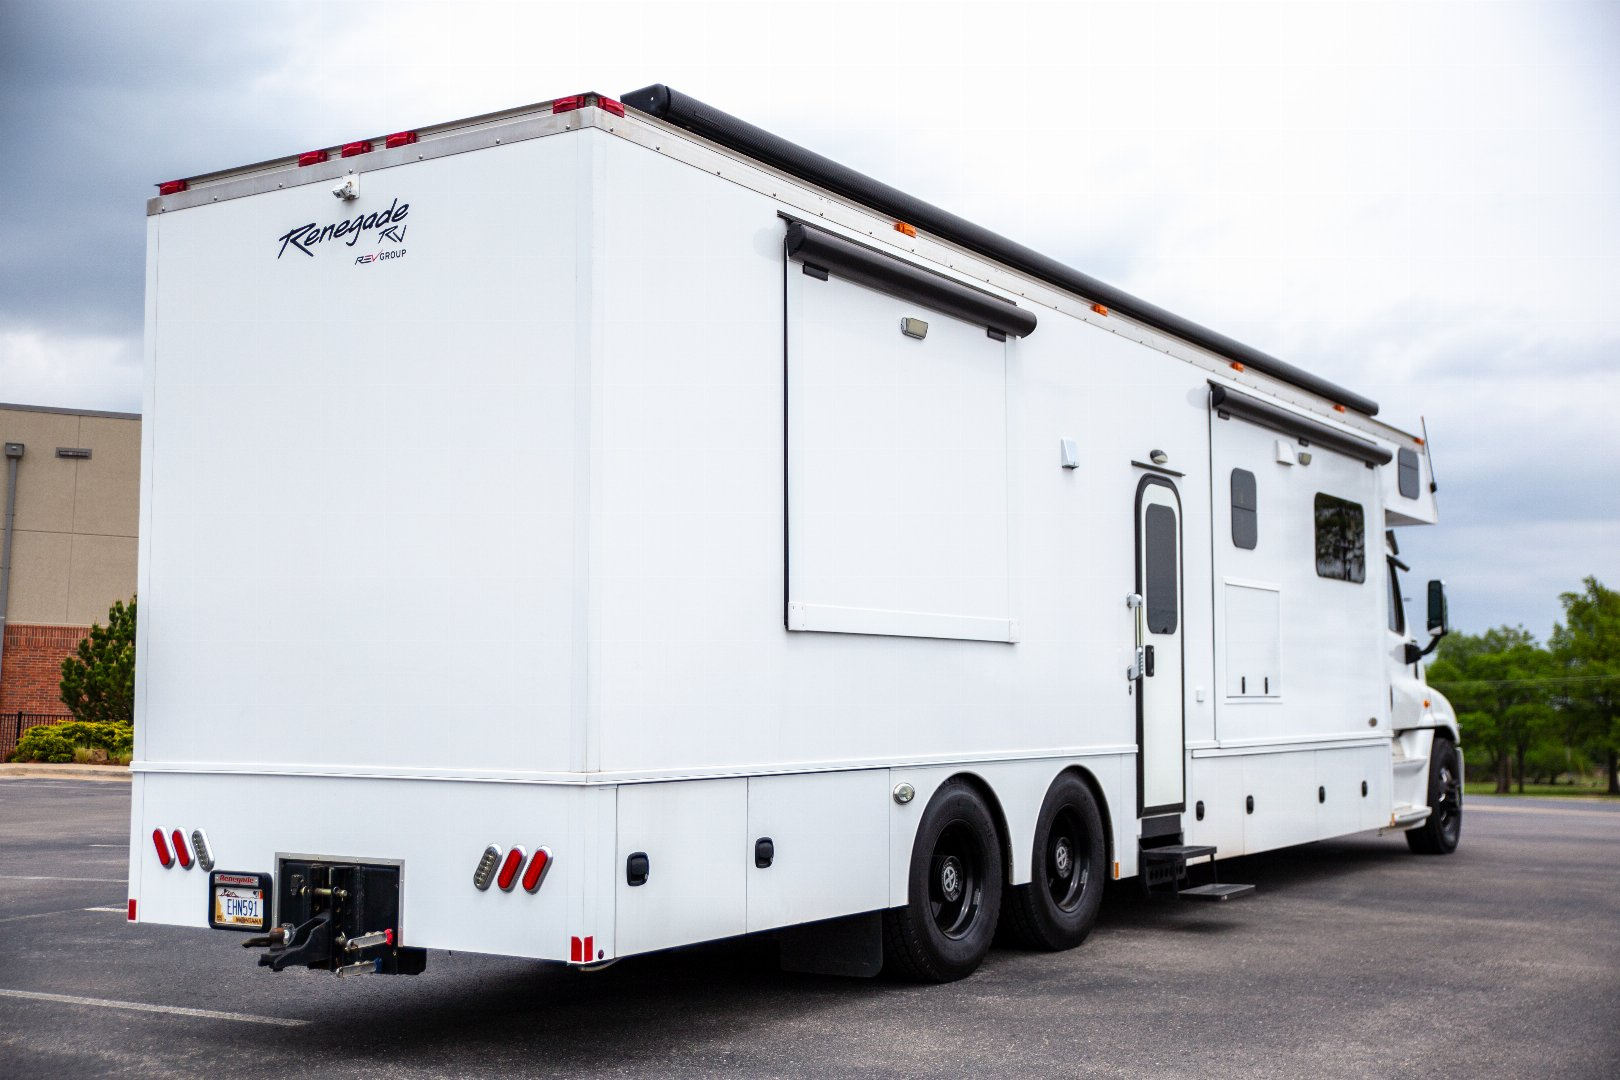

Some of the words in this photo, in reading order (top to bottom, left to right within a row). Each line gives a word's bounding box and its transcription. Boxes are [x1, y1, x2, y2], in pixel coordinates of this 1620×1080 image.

[278, 198, 410, 259] Renegade
[378, 225, 407, 244] RV
[380, 249, 407, 261] GROUP
[220, 875, 254, 884] Renegade
[227, 899, 258, 916] EHN591
